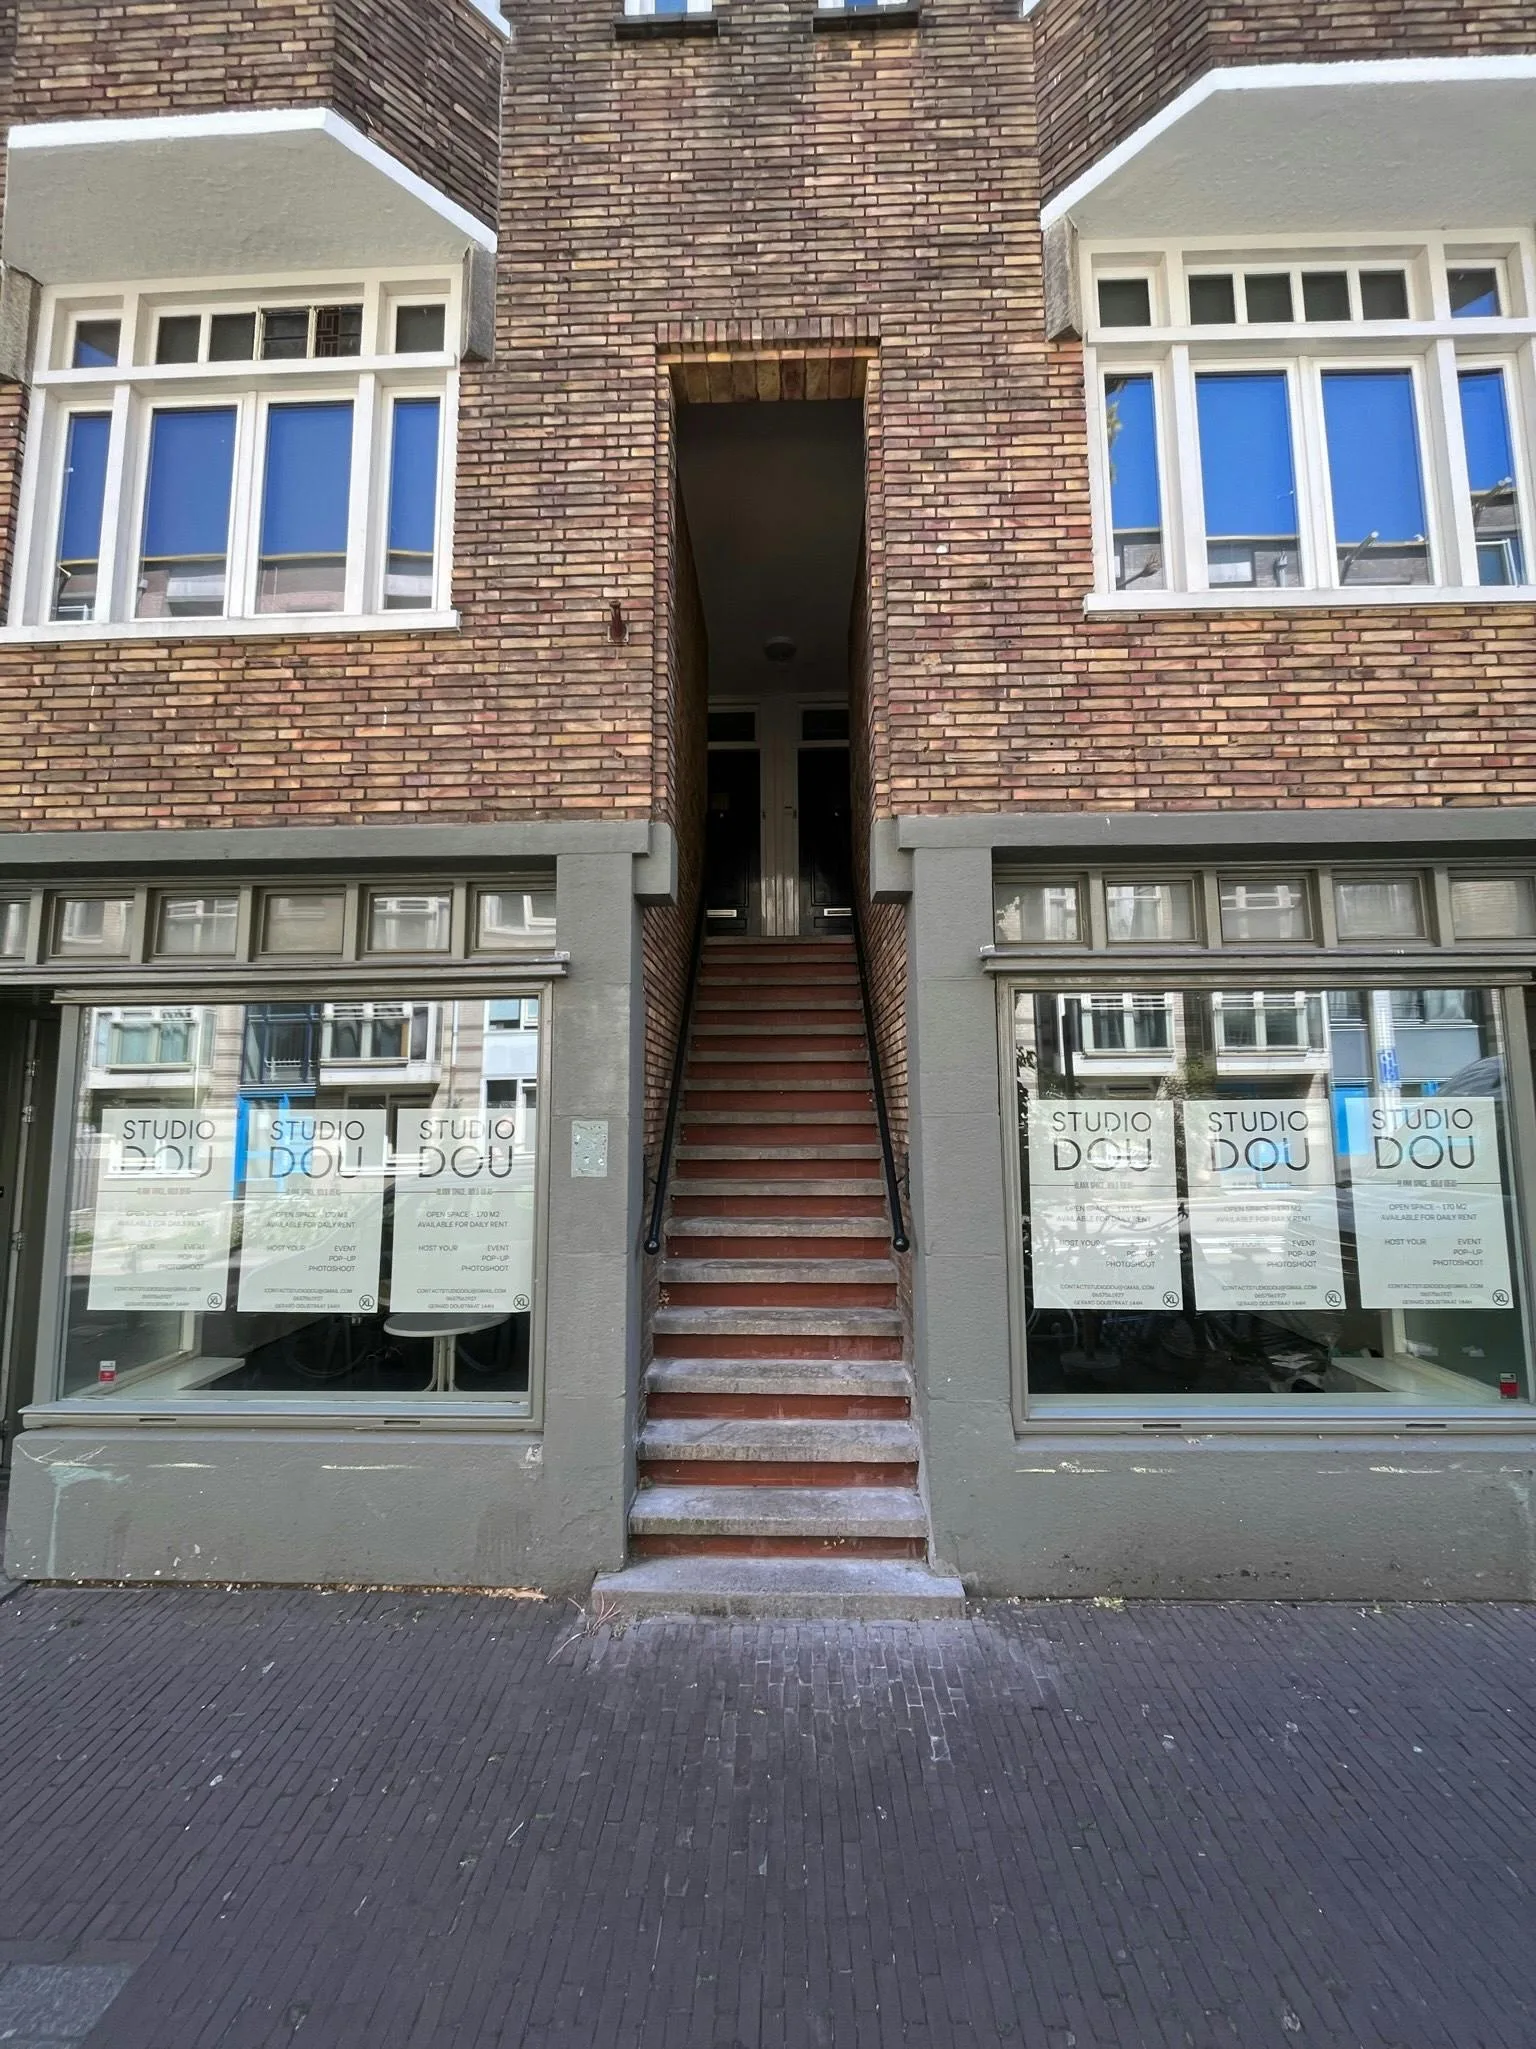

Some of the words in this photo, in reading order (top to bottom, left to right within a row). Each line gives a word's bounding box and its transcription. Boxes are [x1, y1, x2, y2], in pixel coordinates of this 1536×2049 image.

[123, 1120, 215, 1140] STUDIO
[419, 1120, 515, 1140] STUDIO
[1052, 1111, 1152, 1132] STUDIO
[1208, 1110, 1308, 1132] STUDIO
[1372, 1108, 1473, 1130] STUDIO
[270, 1120, 365, 1141] STUDIO
[269, 1146, 362, 1178] DOU
[419, 1145, 513, 1178] DOU
[1053, 1137, 1152, 1172] DOU
[1210, 1137, 1310, 1172] DOU
[1374, 1135, 1475, 1170] DOU
